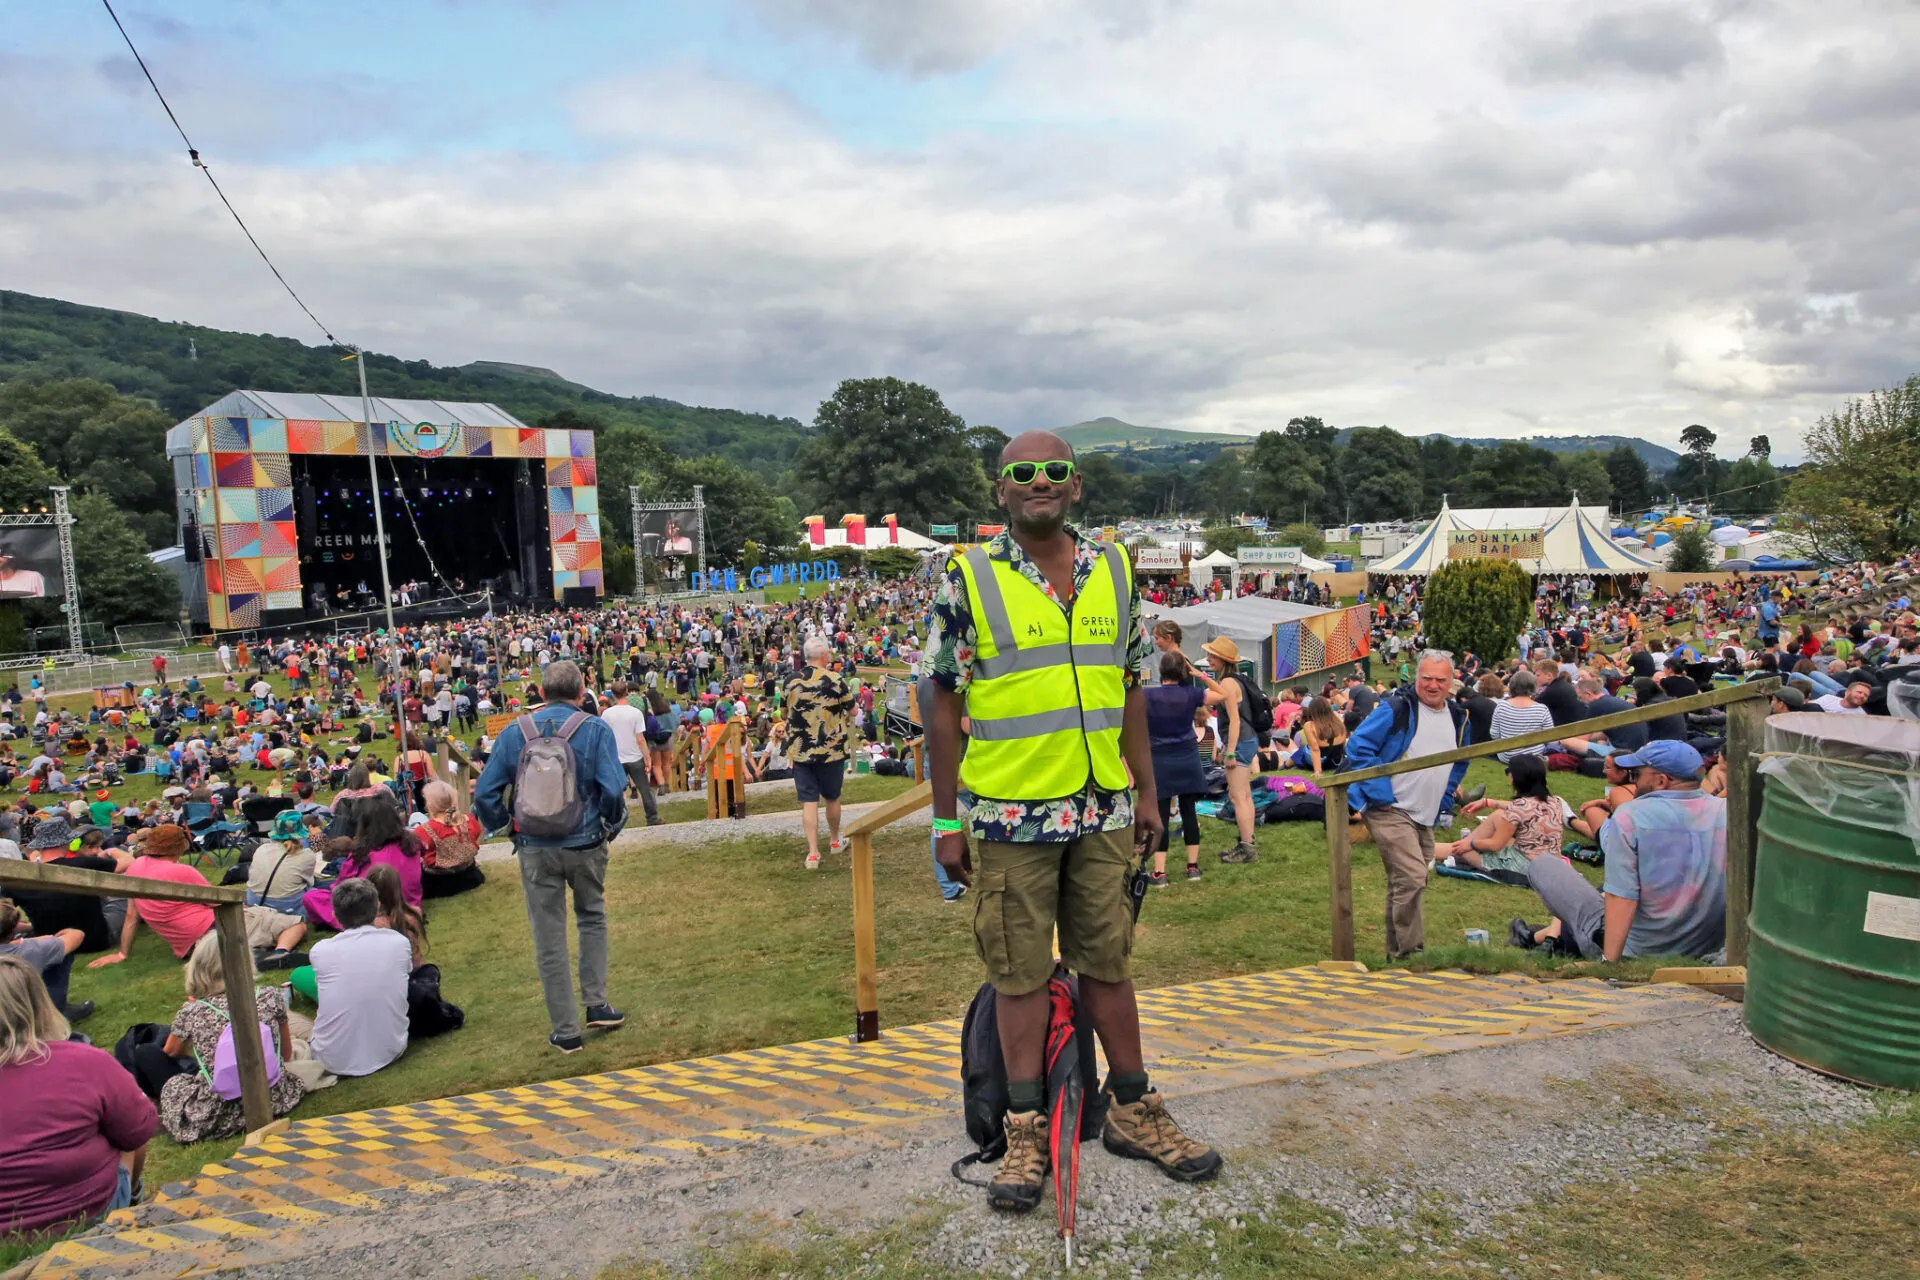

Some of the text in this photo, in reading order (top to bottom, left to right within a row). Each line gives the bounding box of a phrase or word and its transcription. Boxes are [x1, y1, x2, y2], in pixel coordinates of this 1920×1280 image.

[314, 532, 391, 547] REEN MAN
[1455, 532, 1538, 543] MOUNTAIN
[1481, 544, 1510, 554] BAR
[1141, 554, 1178, 565] Smokery
[1275, 551, 1296, 559] INFO
[691, 559, 841, 592] DYN GWYRDD
[1081, 616, 1115, 626] GREEN
